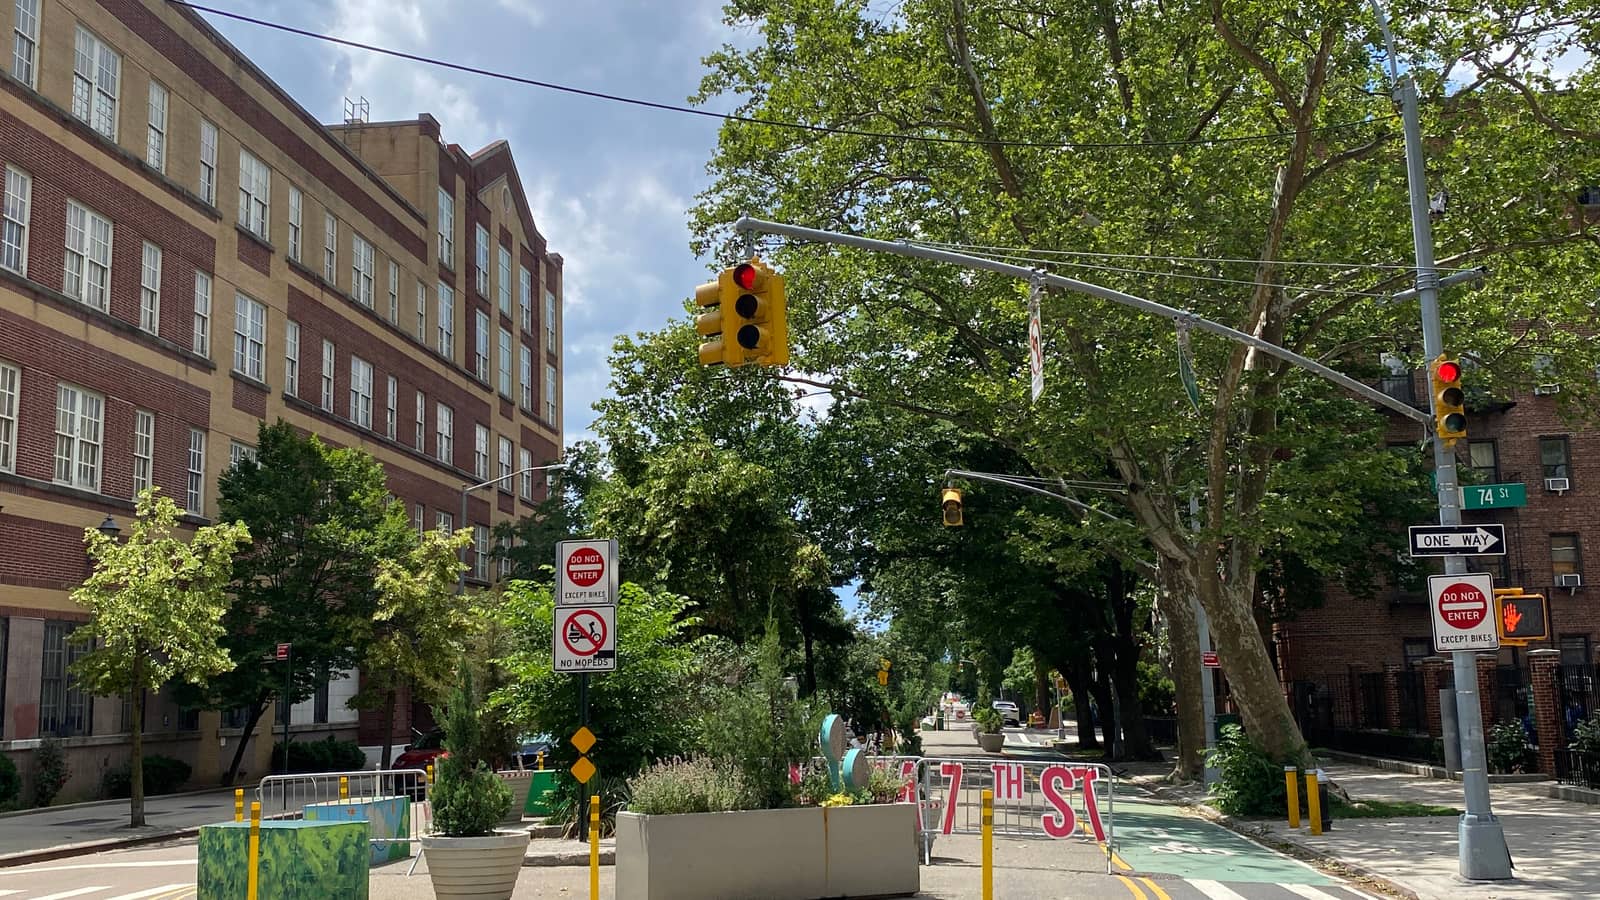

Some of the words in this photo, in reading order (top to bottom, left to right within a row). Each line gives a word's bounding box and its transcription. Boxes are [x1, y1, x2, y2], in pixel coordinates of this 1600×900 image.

[1477, 488, 1494, 505] 74
[1499, 487, 1509, 498] St
[1423, 535, 1450, 547] ONE
[1462, 534, 1489, 546] WAY
[571, 555, 583, 564] DO
[584, 554, 600, 563] NOT
[572, 571, 598, 580] ENTER
[565, 591, 587, 599] EXCEPT
[588, 590, 606, 598] BIKES
[1443, 592, 1457, 602] DO
[1460, 591, 1480, 600] NOT
[1448, 611, 1480, 621] ENTER
[1440, 634, 1468, 644] EXCEPT
[1470, 633, 1493, 643] BIKES
[560, 659, 572, 667] NO
[575, 658, 608, 667] MOPEDS
